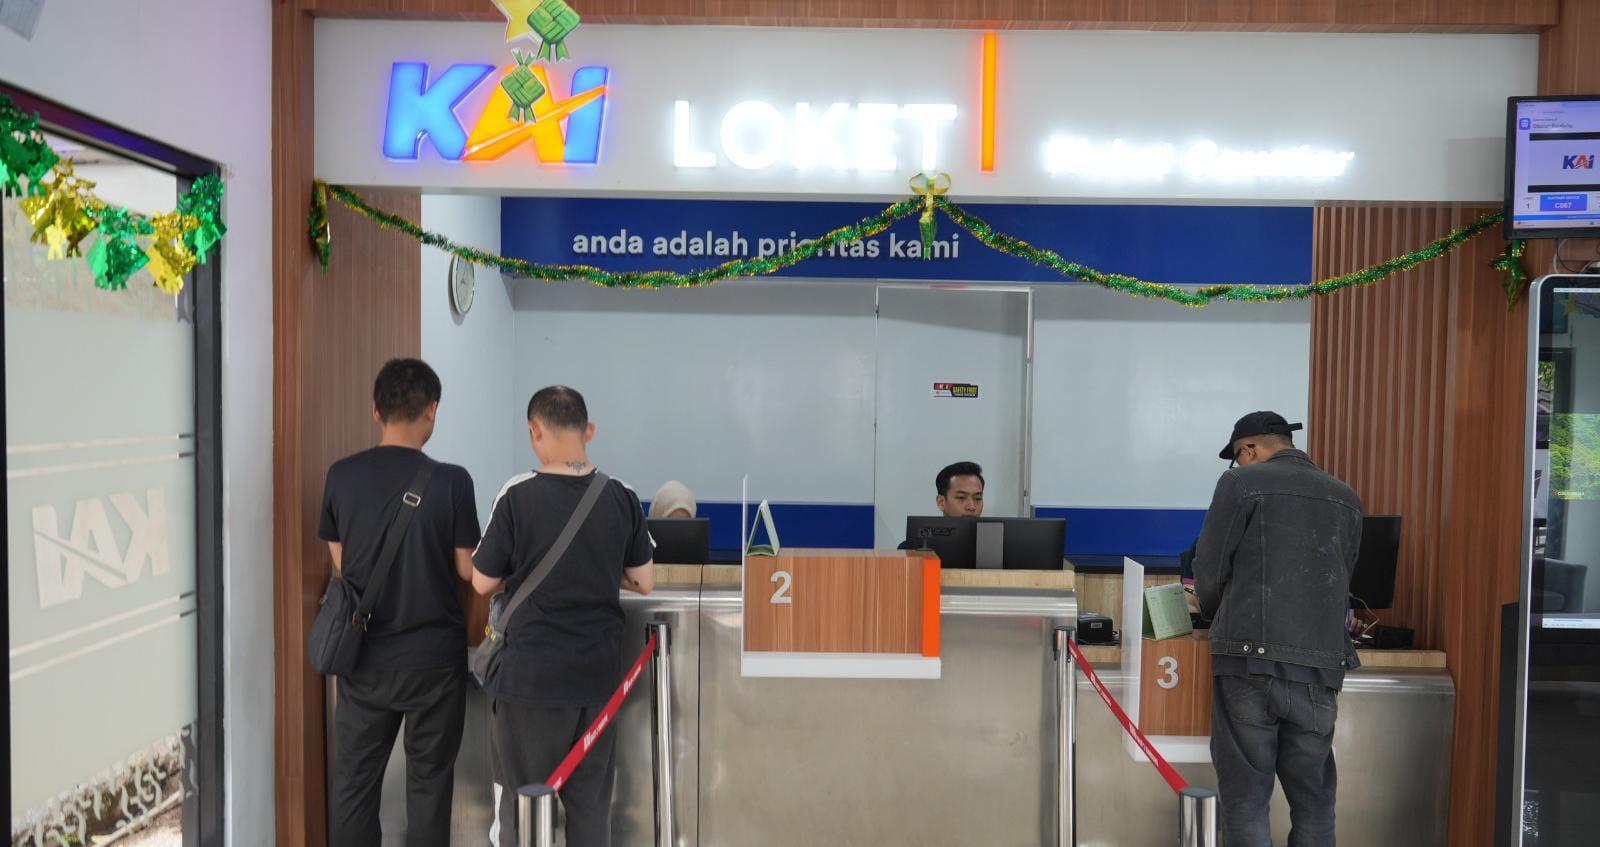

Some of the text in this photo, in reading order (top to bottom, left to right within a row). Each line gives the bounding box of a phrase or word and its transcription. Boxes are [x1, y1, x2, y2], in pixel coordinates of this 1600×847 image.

[383, 61, 608, 164] KAI
[674, 101, 958, 170] LOKET
[573, 229, 643, 254] anda
[653, 230, 748, 256] adalah
[889, 233, 960, 258] kami
[770, 571, 792, 603] 2
[1157, 656, 1179, 689] 3
